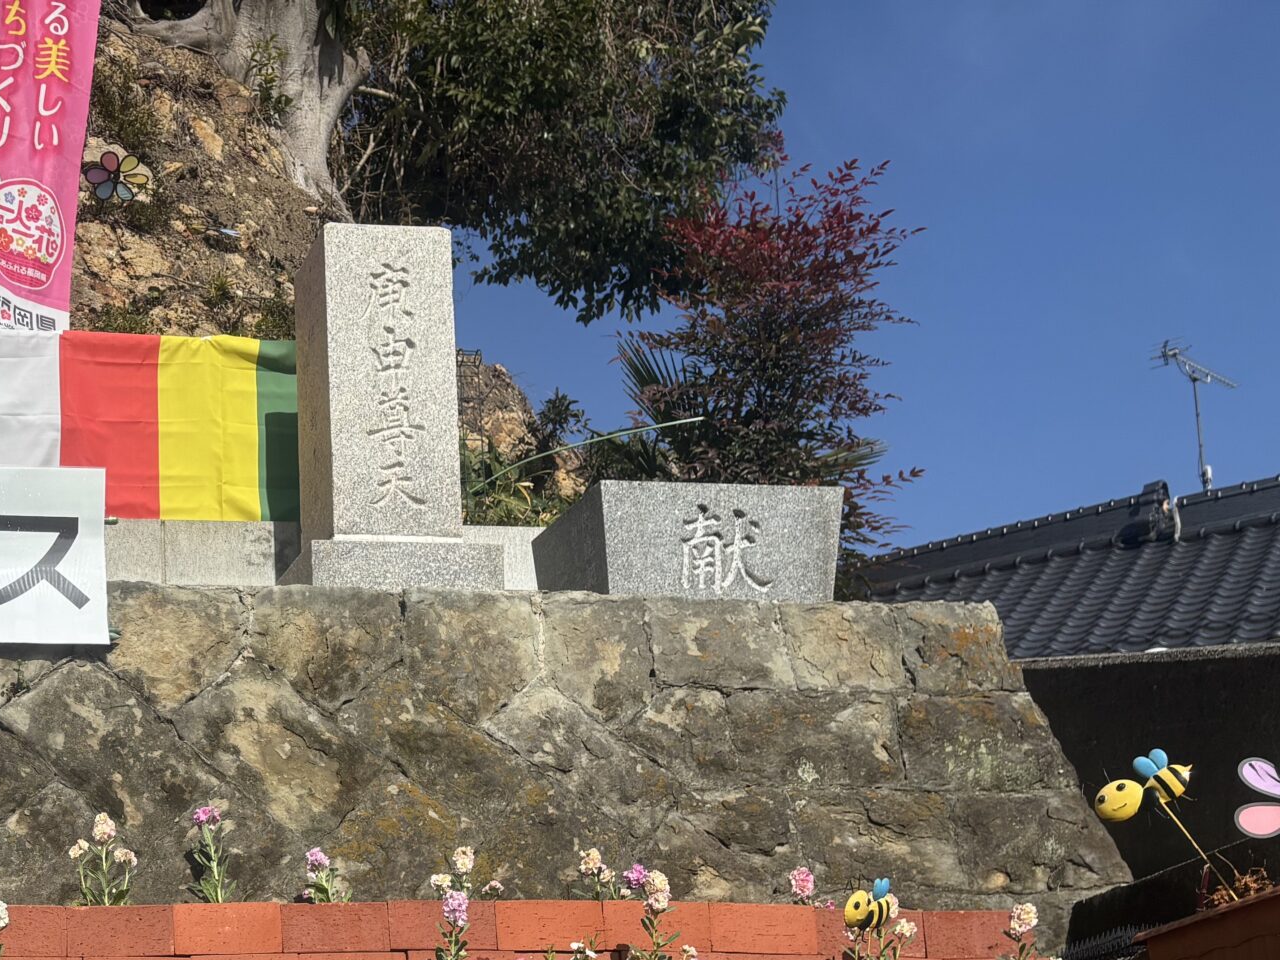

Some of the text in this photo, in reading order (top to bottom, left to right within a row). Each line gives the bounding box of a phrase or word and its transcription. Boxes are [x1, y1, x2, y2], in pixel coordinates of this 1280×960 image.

[34, 1, 70, 150] る美しい
[680, 503, 773, 595] 献
